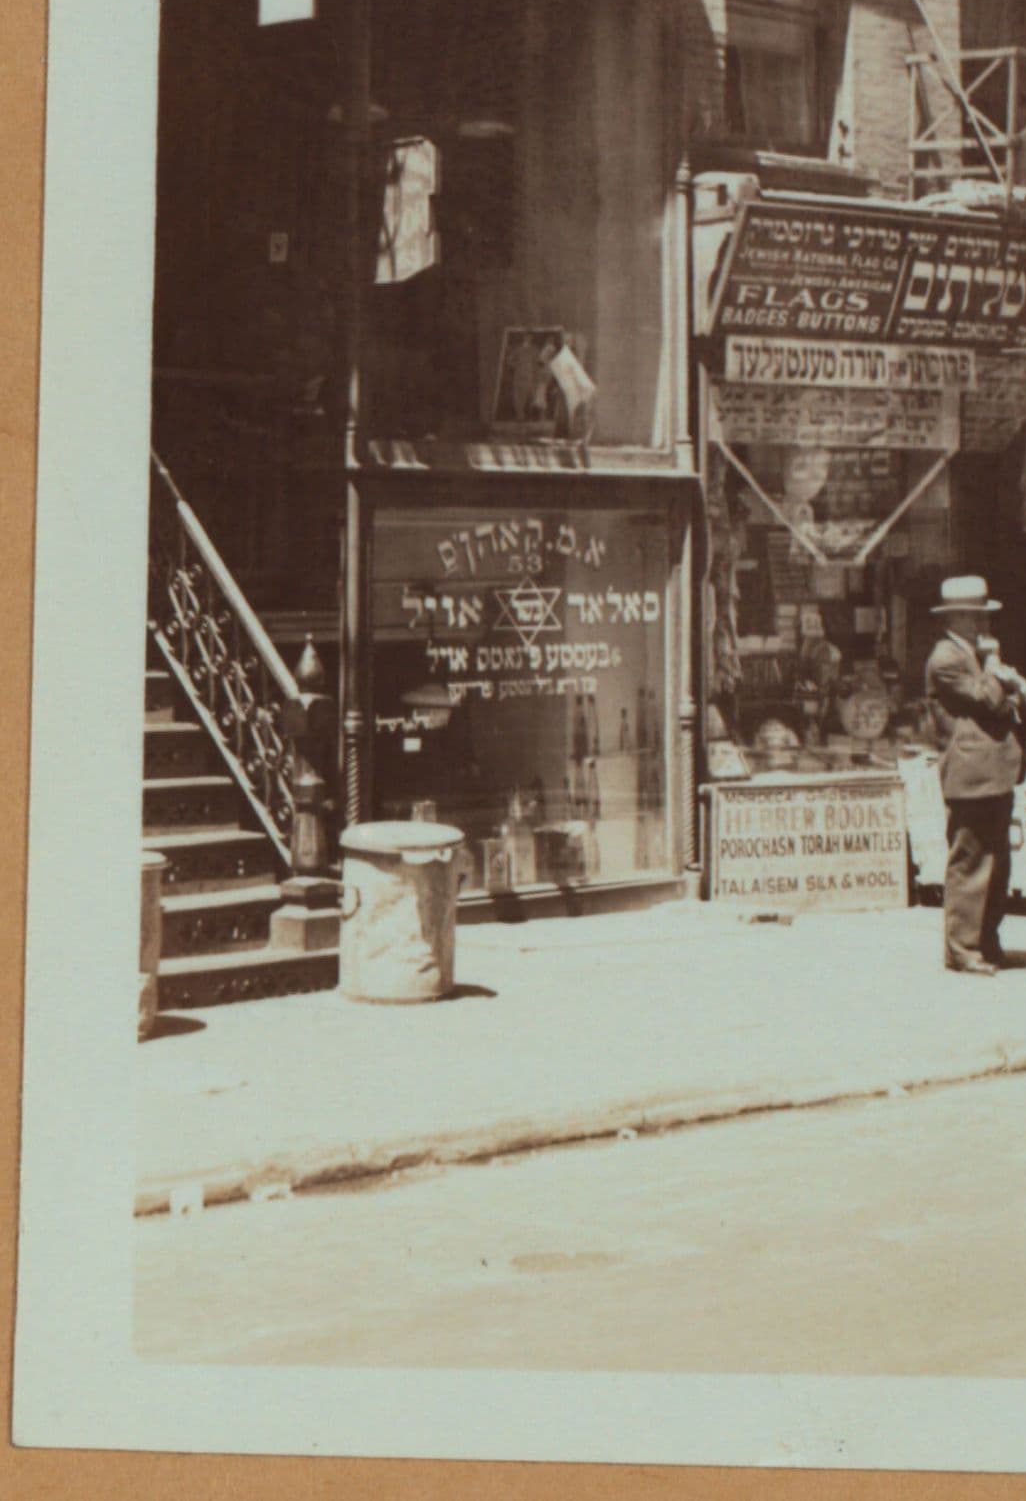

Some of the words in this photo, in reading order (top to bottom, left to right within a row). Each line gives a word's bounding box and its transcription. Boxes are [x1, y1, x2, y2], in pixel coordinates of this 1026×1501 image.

[843, 225, 901, 252] מרדכי
[738, 247, 790, 262] JEWISH
[793, 250, 848, 267] NATIONAL
[851, 253, 880, 270] FLAG
[735, 283, 871, 313] FLAGS
[721, 306, 790, 327] BADGES
[796, 312, 882, 335] BUTTONS
[732, 342, 837, 381] מענטעלעך
[838, 348, 886, 382] תורה
[725, 805, 816, 835] HEBREW
[823, 802, 898, 830] BOOKS
[720, 836, 796, 860] POROCHASN
[800, 834, 842, 855] TORAH
[843, 831, 902, 854] MANTLES
[720, 875, 799, 896] TALAISEM
[841, 873, 853, 890] &
[856, 870, 898, 888] WOOL
